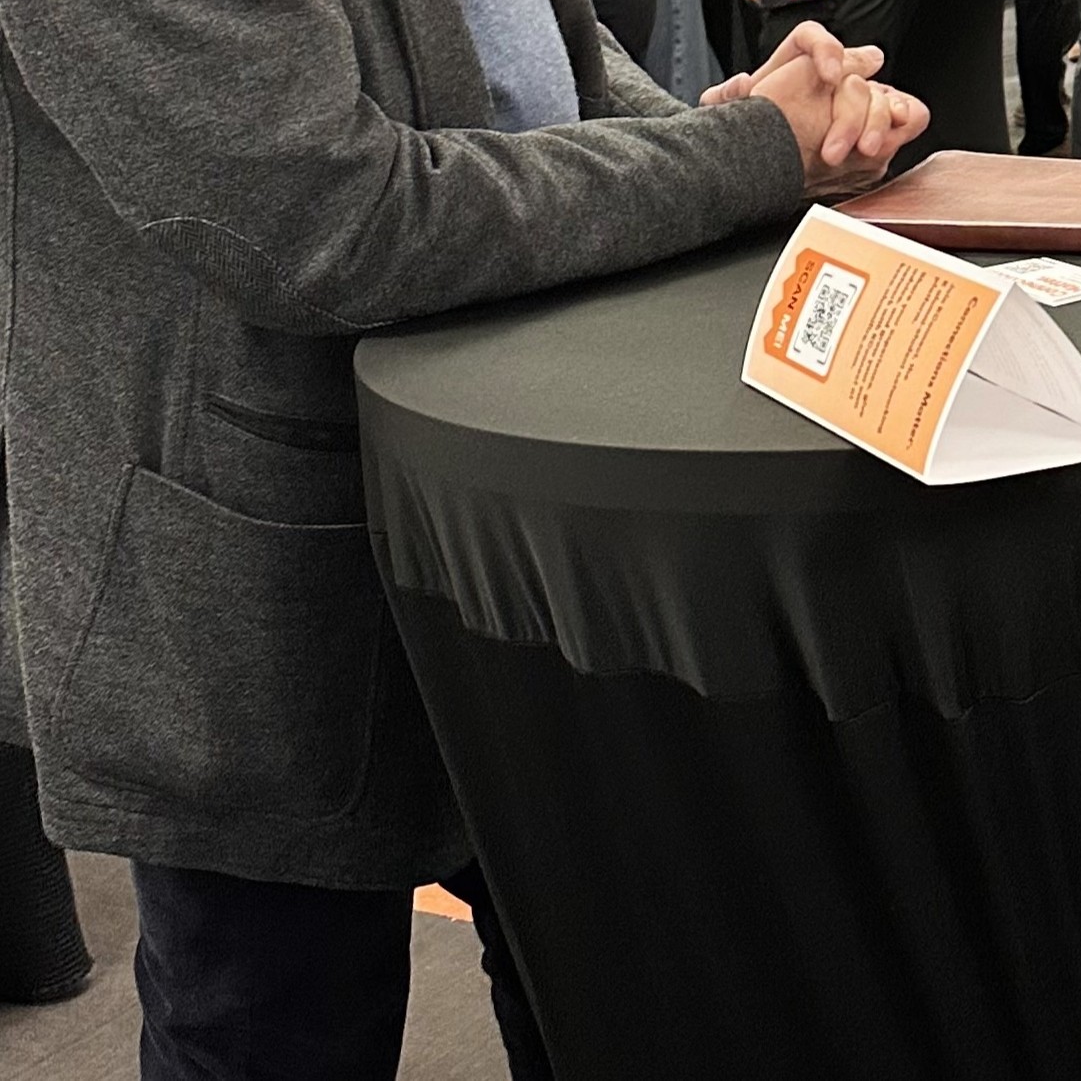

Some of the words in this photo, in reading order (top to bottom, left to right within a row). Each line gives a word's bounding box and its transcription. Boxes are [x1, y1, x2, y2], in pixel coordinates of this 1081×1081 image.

[787, 259, 814, 311] SCAN
[773, 312, 791, 350] ME!
[927, 295, 979, 389] Connections
